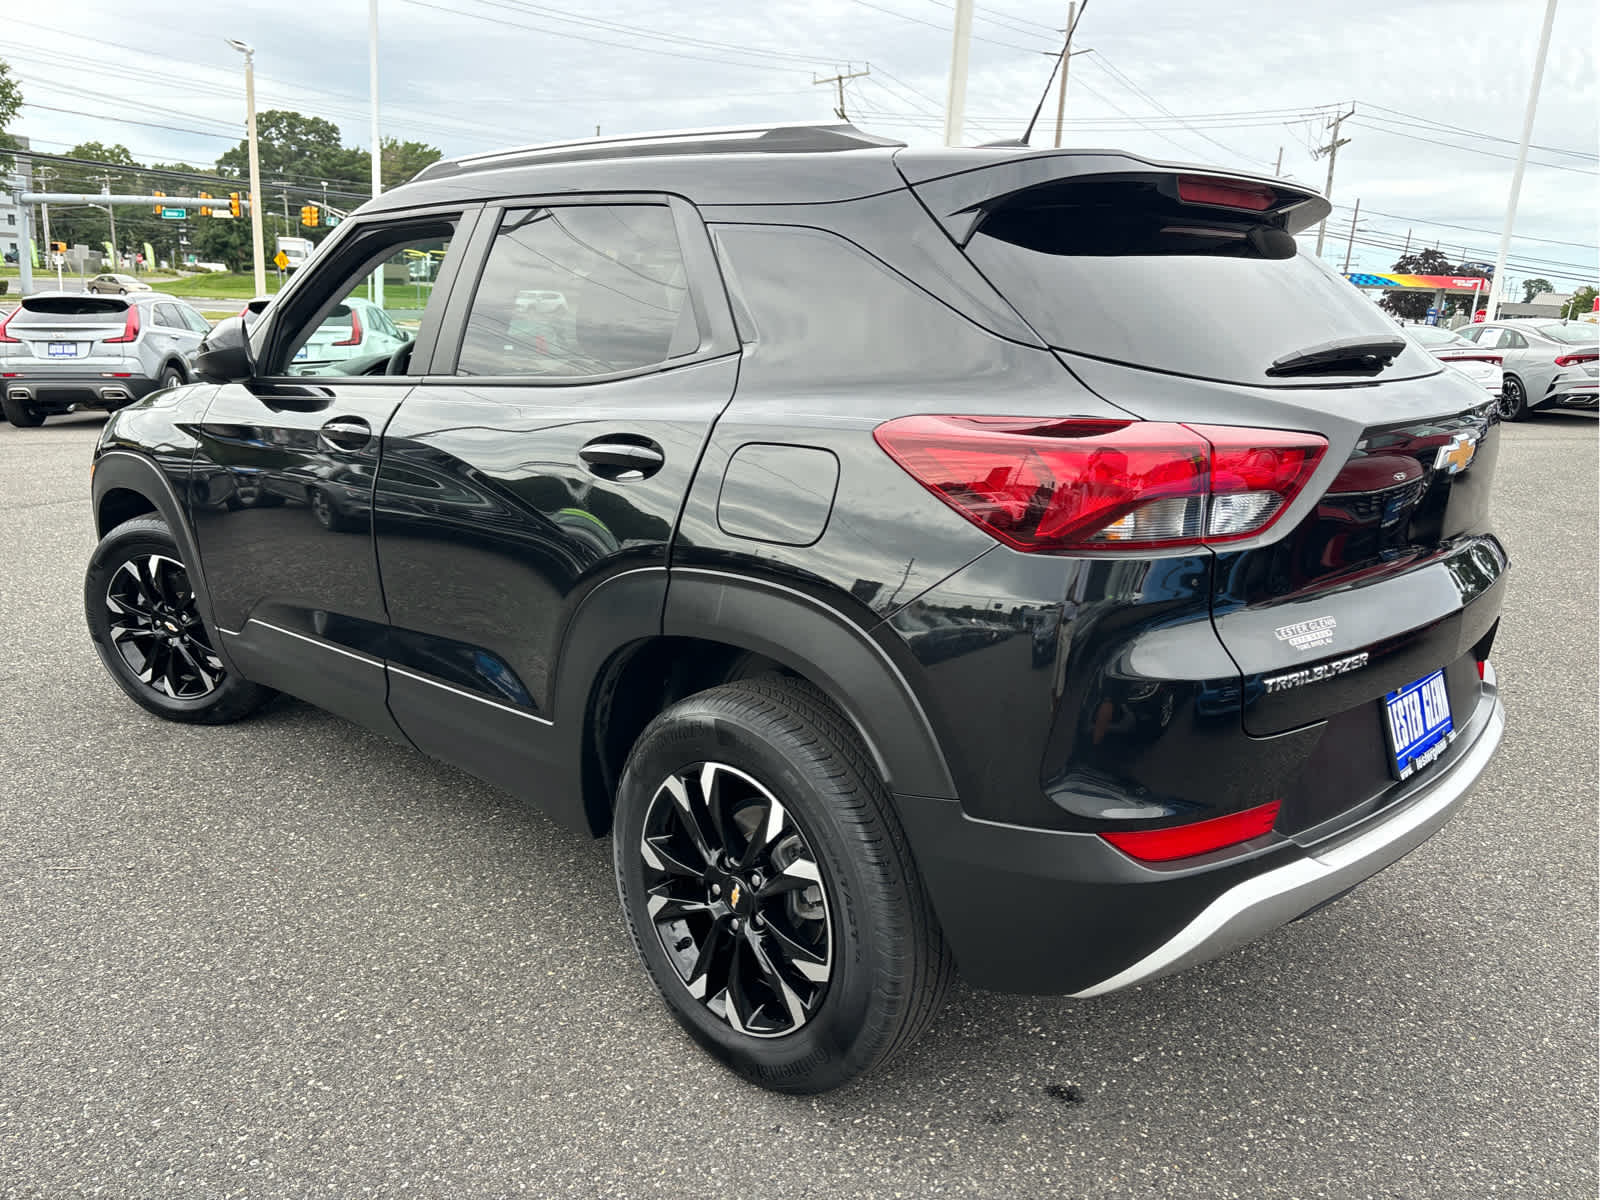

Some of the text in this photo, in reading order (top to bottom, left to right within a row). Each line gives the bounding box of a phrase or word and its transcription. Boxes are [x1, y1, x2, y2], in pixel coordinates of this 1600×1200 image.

[1274, 622, 1309, 640] LESTER
[1263, 652, 1369, 693] TRAILBLAZER
[1387, 674, 1451, 753] LESTER GLENN
